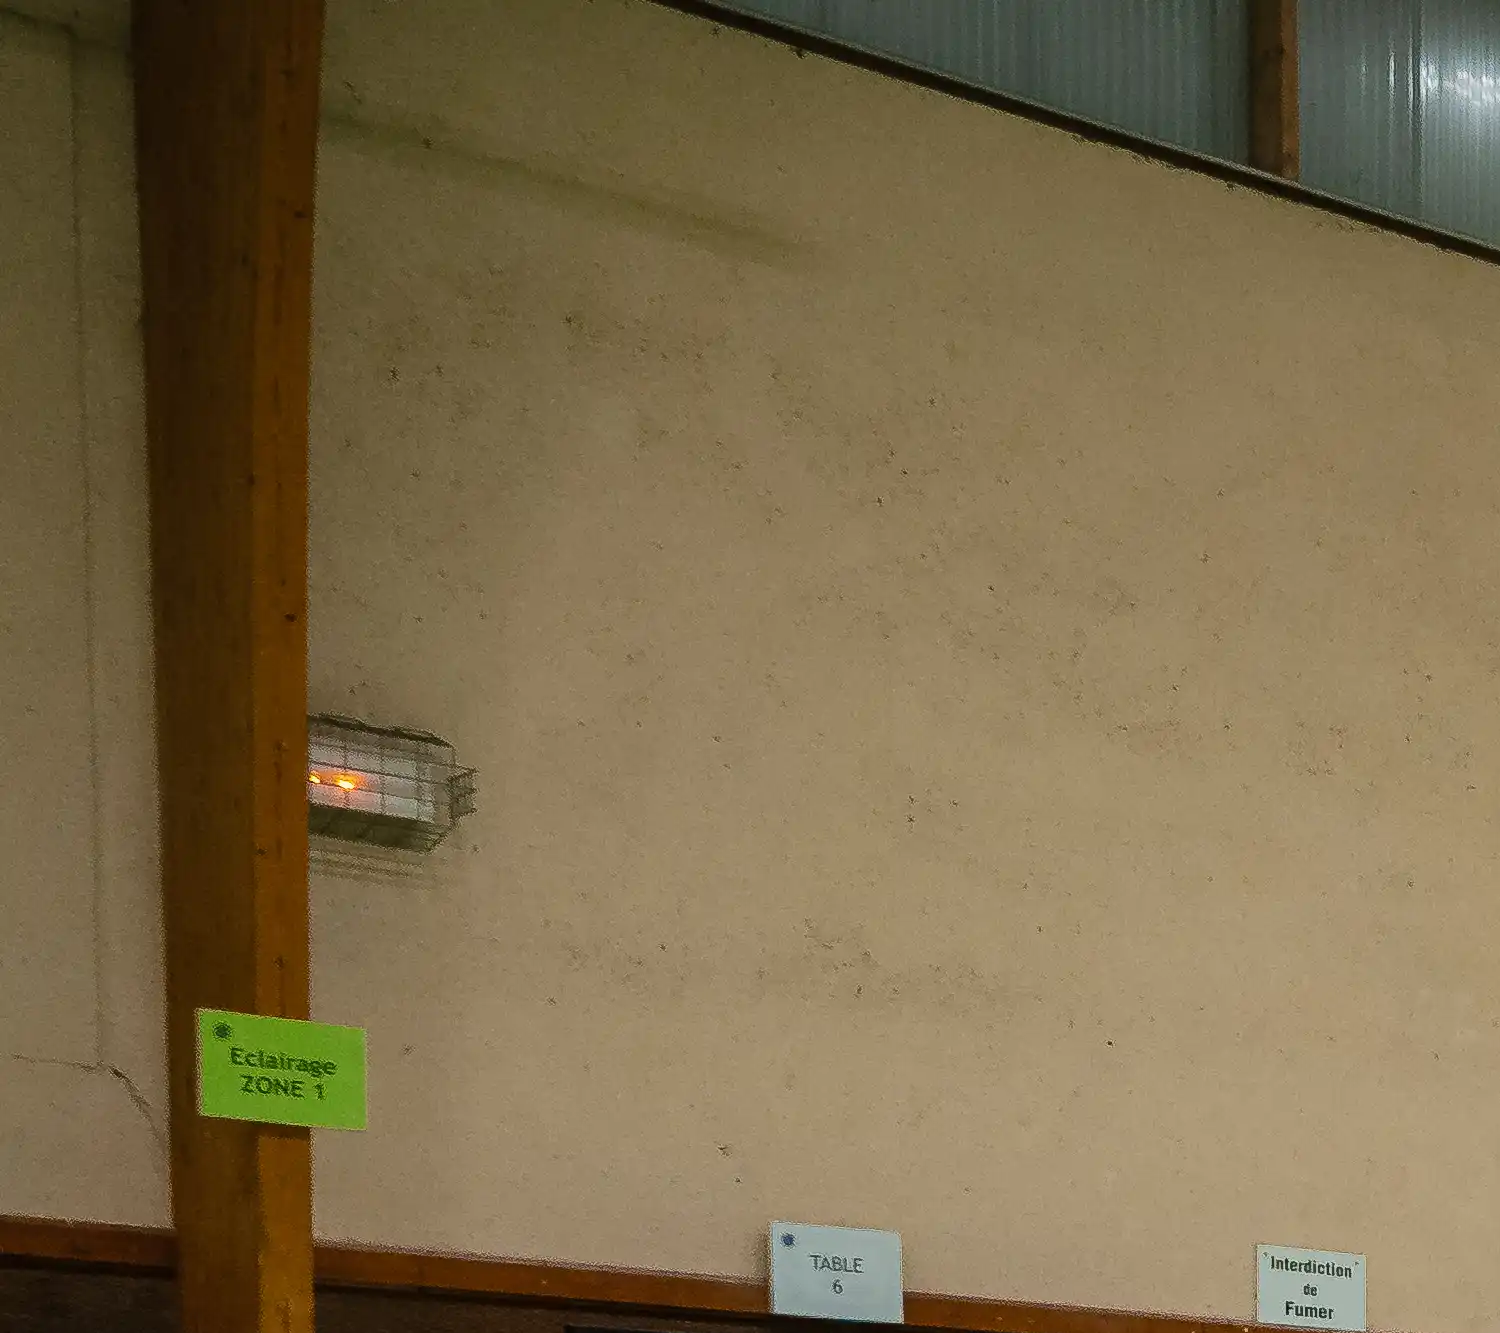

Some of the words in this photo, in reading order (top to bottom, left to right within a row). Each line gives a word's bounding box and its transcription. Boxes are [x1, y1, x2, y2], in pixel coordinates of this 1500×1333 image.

[230, 1047, 338, 1079] Eclairage
[240, 1074, 305, 1099] ZONE
[314, 1083, 325, 1100] 1
[809, 1254, 865, 1275] TABLE
[1270, 1256, 1352, 1279] Interdiction
[832, 1278, 844, 1296] 6
[1303, 1281, 1318, 1297] de
[1285, 1300, 1334, 1319] Fumer
